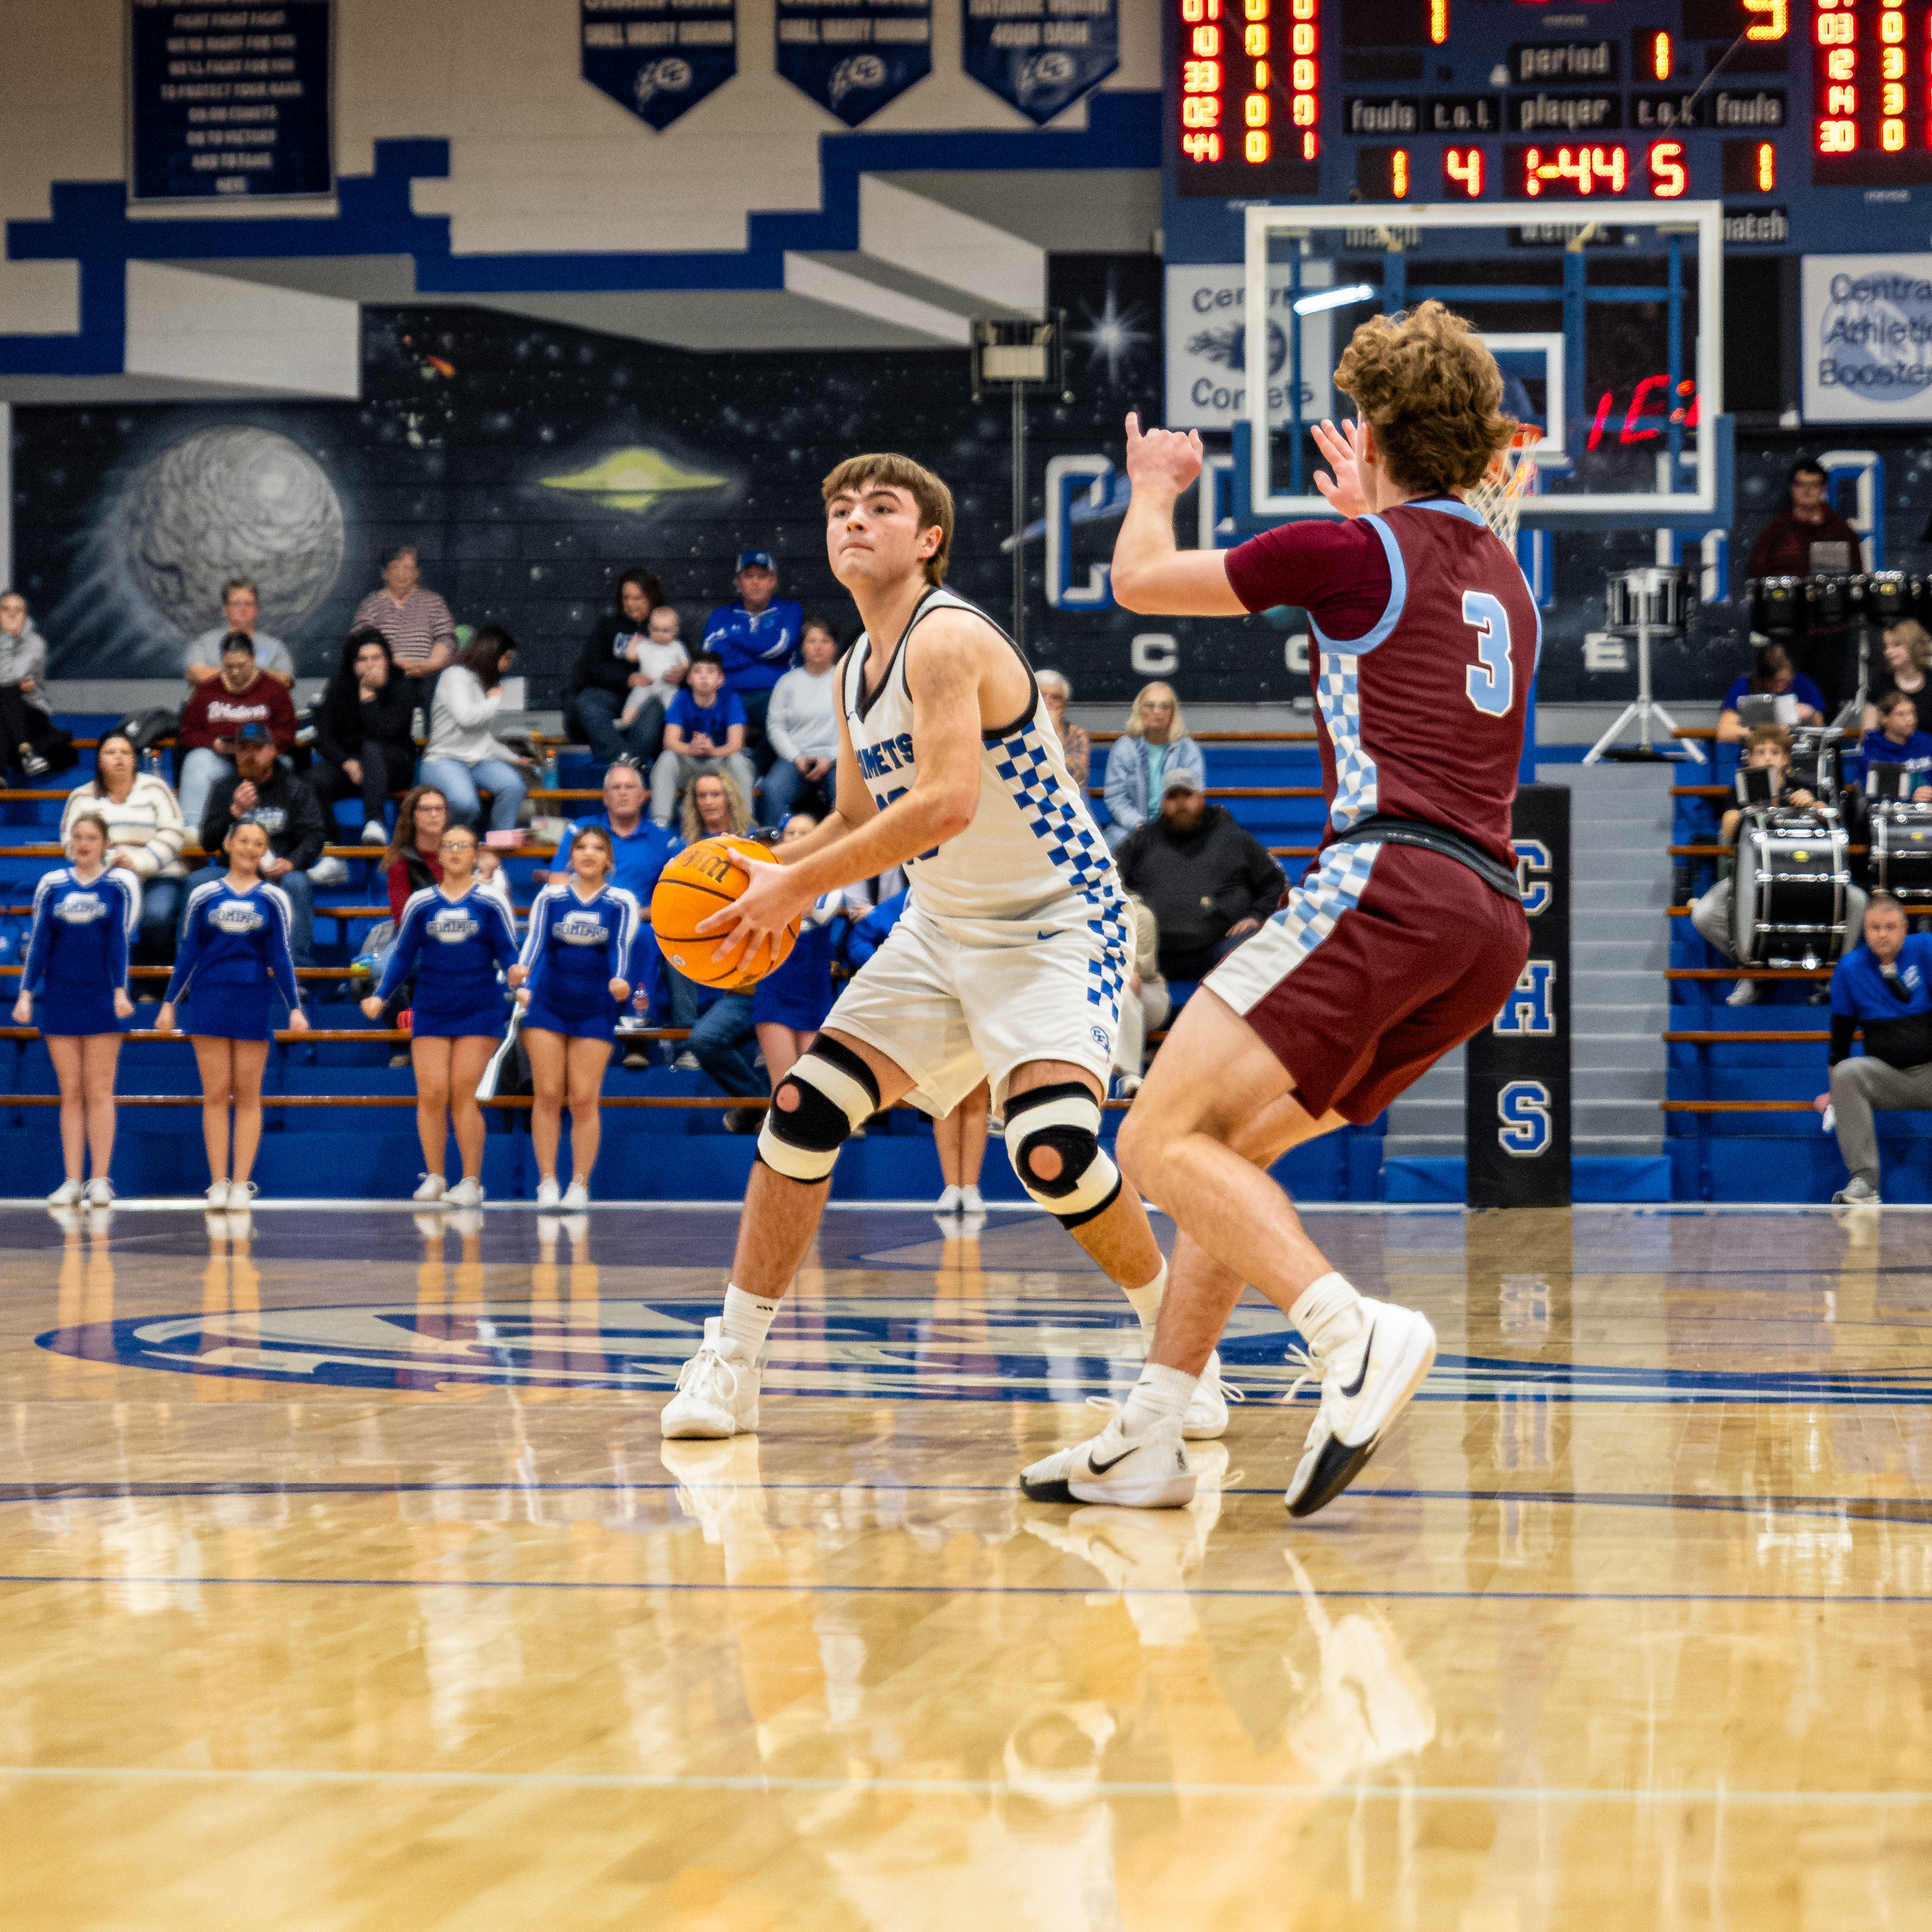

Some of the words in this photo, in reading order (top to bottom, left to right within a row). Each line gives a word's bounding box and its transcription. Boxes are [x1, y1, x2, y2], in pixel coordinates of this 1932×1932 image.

[1293, 24, 1314, 55] 0
[1882, 11, 1903, 44] 0
[1521, 42, 1610, 80] period
[1655, 32, 1669, 81] 1
[1883, 47, 1904, 80] 3
[1293, 59, 1314, 90] 0
[1245, 95, 1266, 127] 0
[1521, 93, 1610, 131] player
[1716, 93, 1780, 123] fouls
[1883, 83, 1904, 115] 3
[1245, 131, 1266, 162] 0
[1304, 131, 1314, 160] 1
[1882, 119, 1904, 151] 0
[1393, 150, 1406, 198] 1
[1447, 150, 1480, 197] 4
[1651, 143, 1684, 197] 5
[1759, 144, 1772, 191] 1
[1462, 590, 1513, 717] 3
